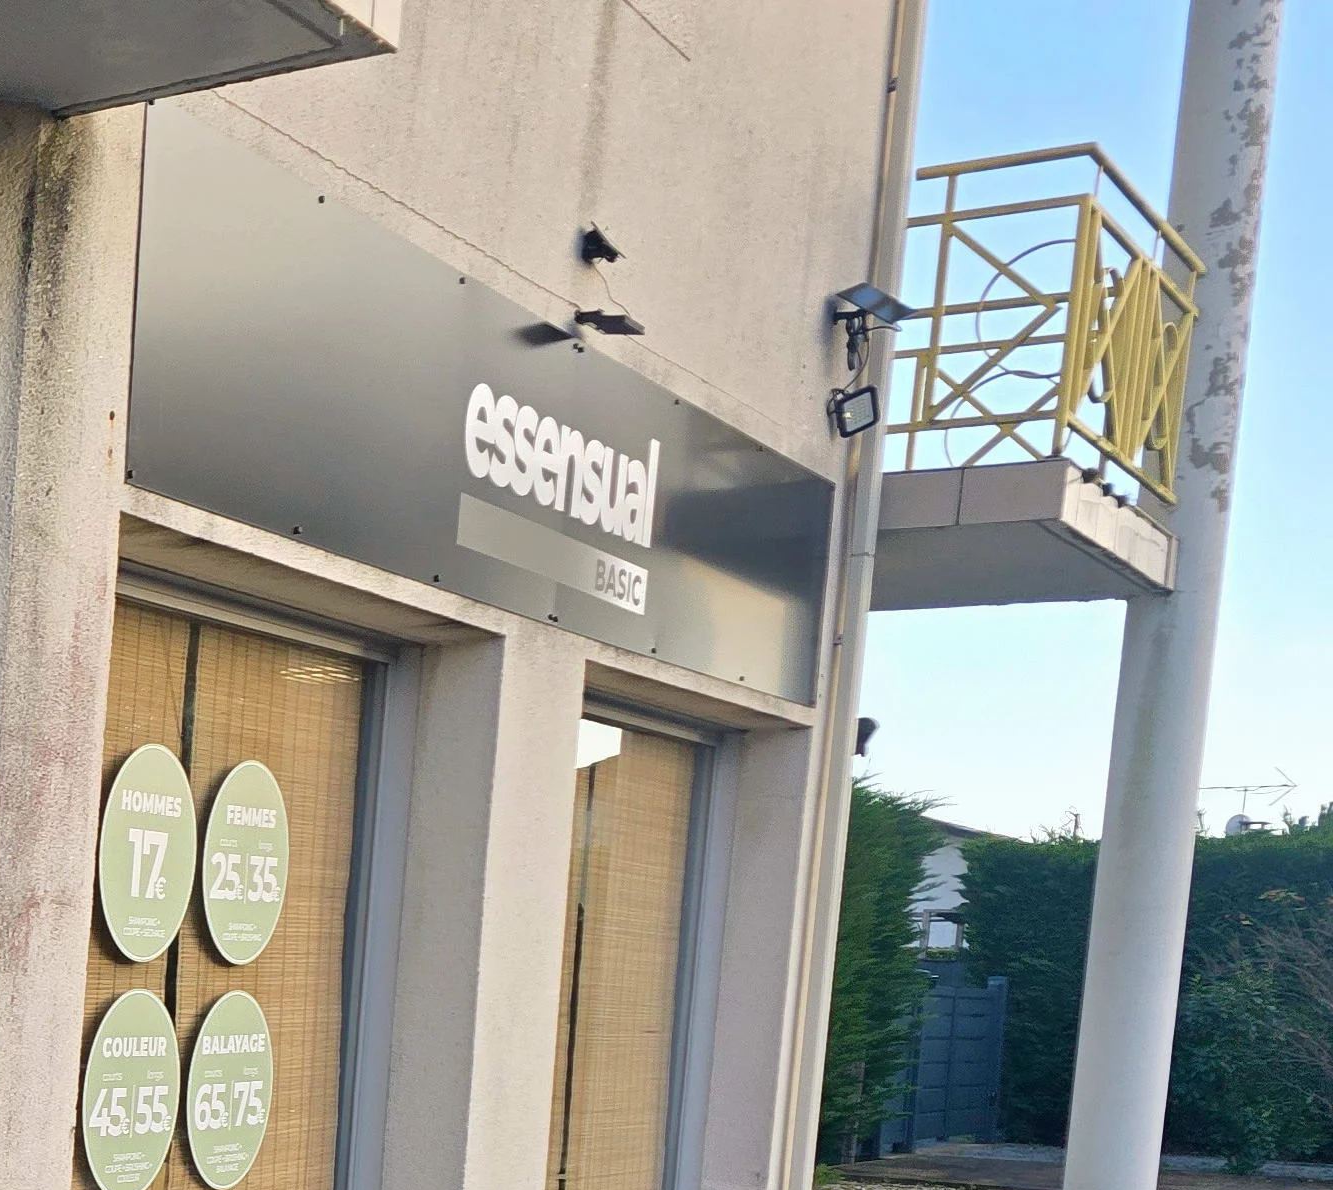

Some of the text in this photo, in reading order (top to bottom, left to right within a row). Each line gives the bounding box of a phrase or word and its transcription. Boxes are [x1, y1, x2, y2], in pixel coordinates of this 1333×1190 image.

[465, 383, 661, 549] essensual
[595, 558, 642, 606] BASIC
[121, 789, 182, 818] HOMMES
[226, 804, 277, 829] FEMMES
[128, 827, 169, 900] 17€
[102, 1036, 167, 1058] COULEUR
[201, 1033, 266, 1056] BALAYAGE
